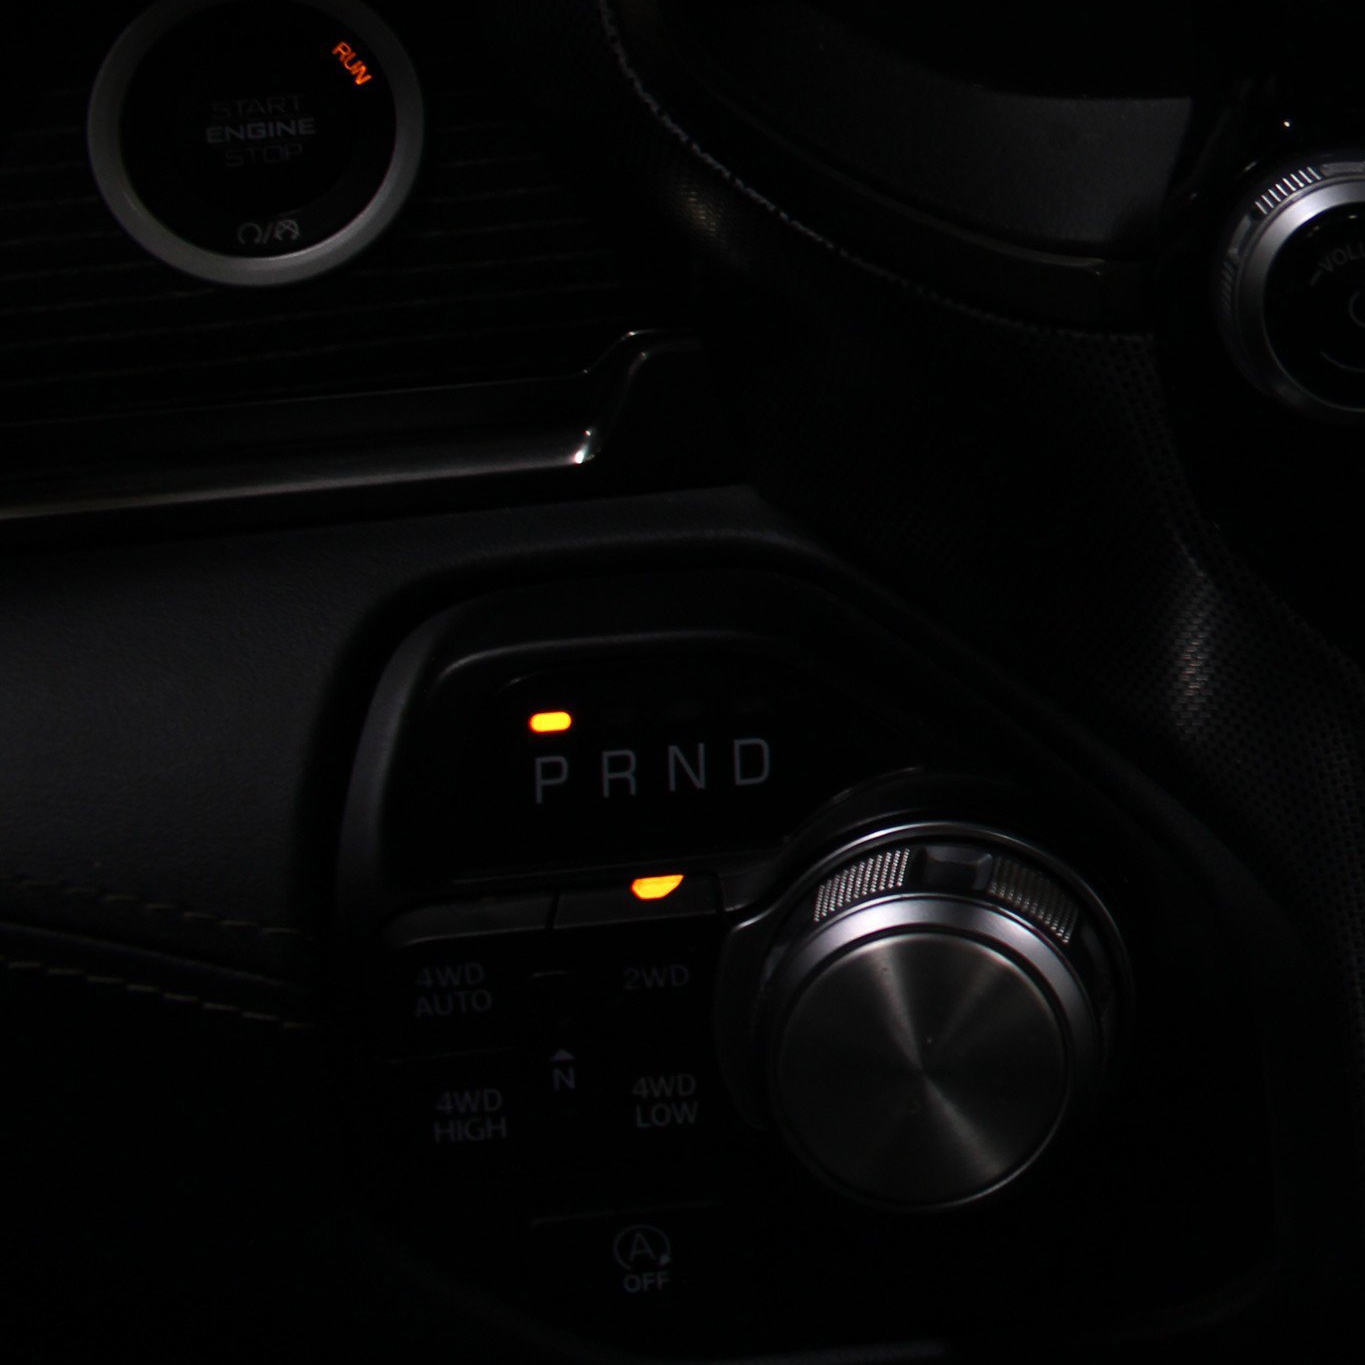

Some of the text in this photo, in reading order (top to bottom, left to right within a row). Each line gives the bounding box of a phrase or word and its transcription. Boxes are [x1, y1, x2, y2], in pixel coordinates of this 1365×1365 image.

[330, 38, 373, 86] RUN
[210, 94, 304, 120] START
[205, 117, 318, 145] ENGINE
[223, 143, 304, 168] STOP
[534, 736, 772, 806] P R N D
[416, 962, 484, 989] 4WD
[623, 963, 690, 990] 2WD
[414, 987, 493, 1019] AUTO
[552, 1064, 576, 1091] N
[631, 1073, 697, 1100] 4WD
[434, 1086, 502, 1115] 4WD
[633, 1099, 700, 1130] LOW
[434, 1115, 508, 1144] HIGH
[622, 1271, 672, 1295] OFF
